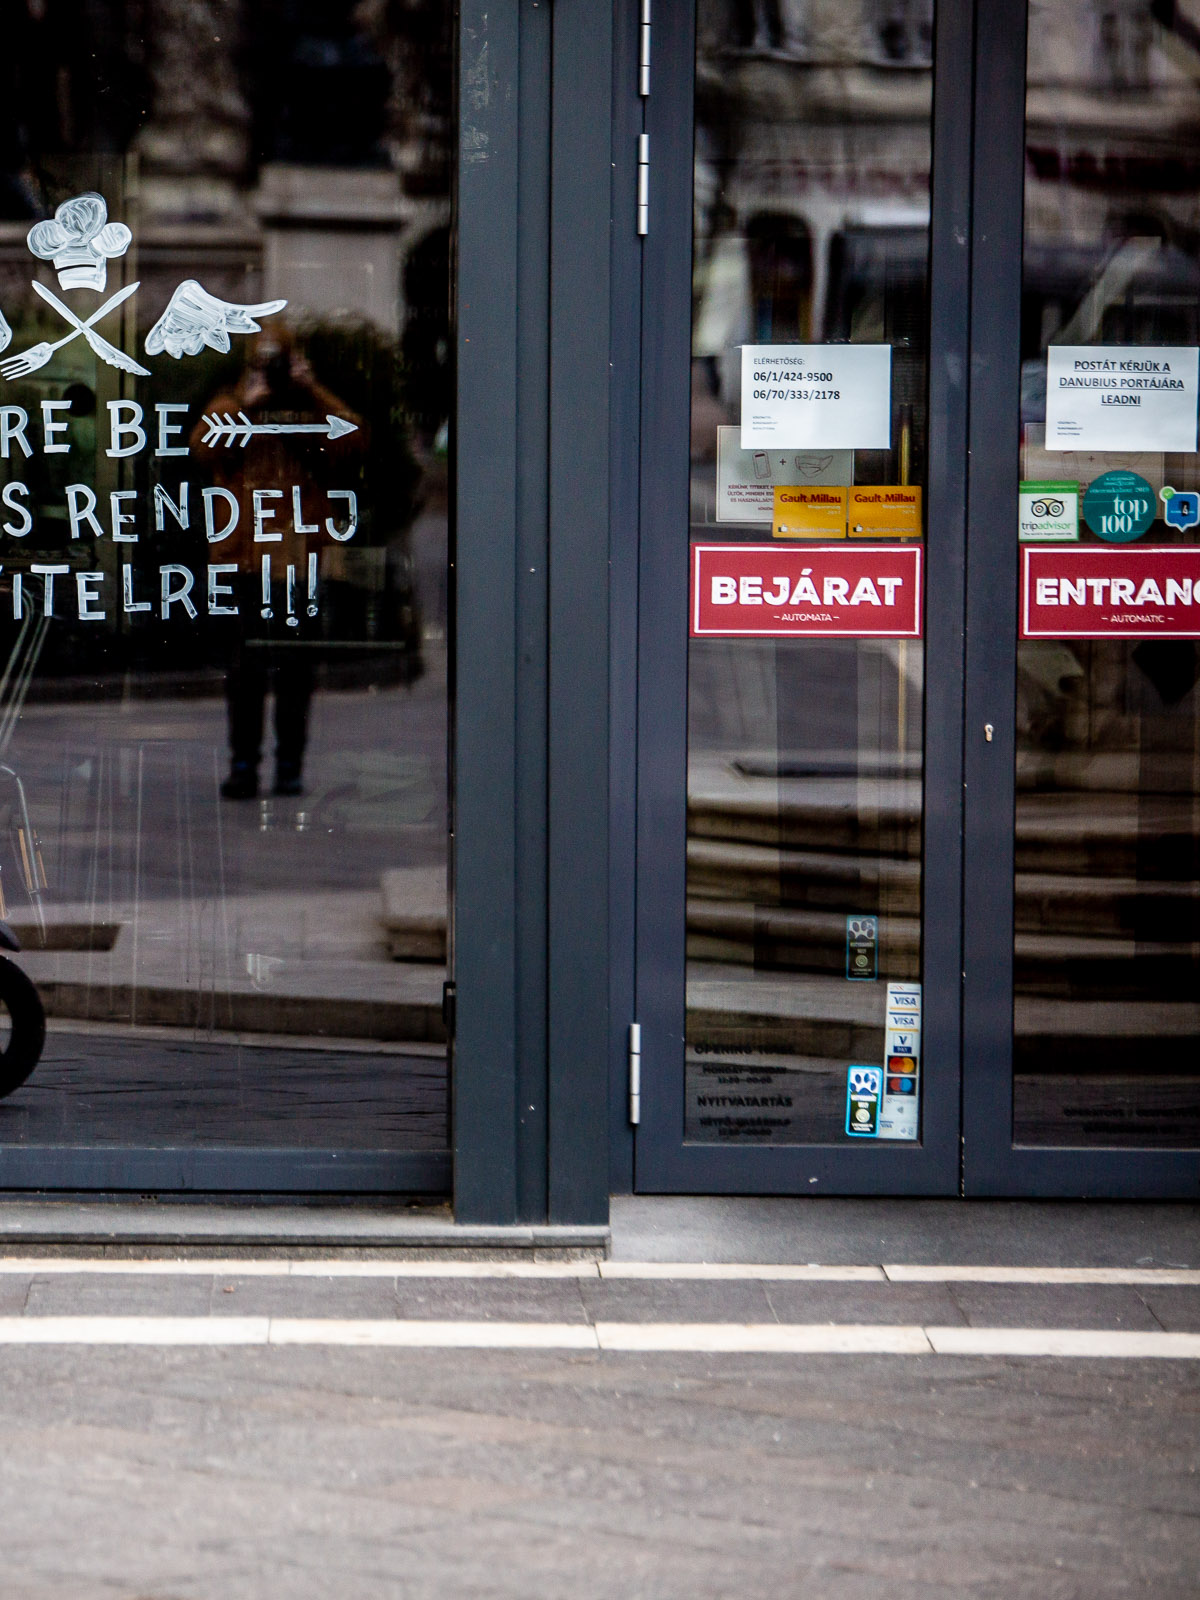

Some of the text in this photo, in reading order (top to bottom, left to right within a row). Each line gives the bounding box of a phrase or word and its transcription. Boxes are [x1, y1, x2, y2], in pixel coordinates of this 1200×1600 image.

[1074, 359, 1171, 372] POSTÁT KÉRJÜK A
[753, 371, 833, 382] 06/1/424-9500
[1059, 377, 1185, 389] DANUBIUS PORTÁJÁRA
[753, 388, 841, 401] 06/70/333/2178
[1101, 394, 1141, 405] LEADNI
[106, 399, 190, 458] BE
[65, 480, 358, 543] RENDELJ
[1113, 494, 1149, 521] top
[1021, 521, 1071, 532] tripadvisor
[1101, 514, 1133, 533] 100
[711, 568, 903, 606] BEJÁRAT
[781, 613, 833, 622] AUTOMATA
[1110, 614, 1165, 623] AUTOMATIC
[893, 996, 917, 1006] VISA
[893, 1016, 915, 1026] VISA
[898, 1035, 908, 1045] V
